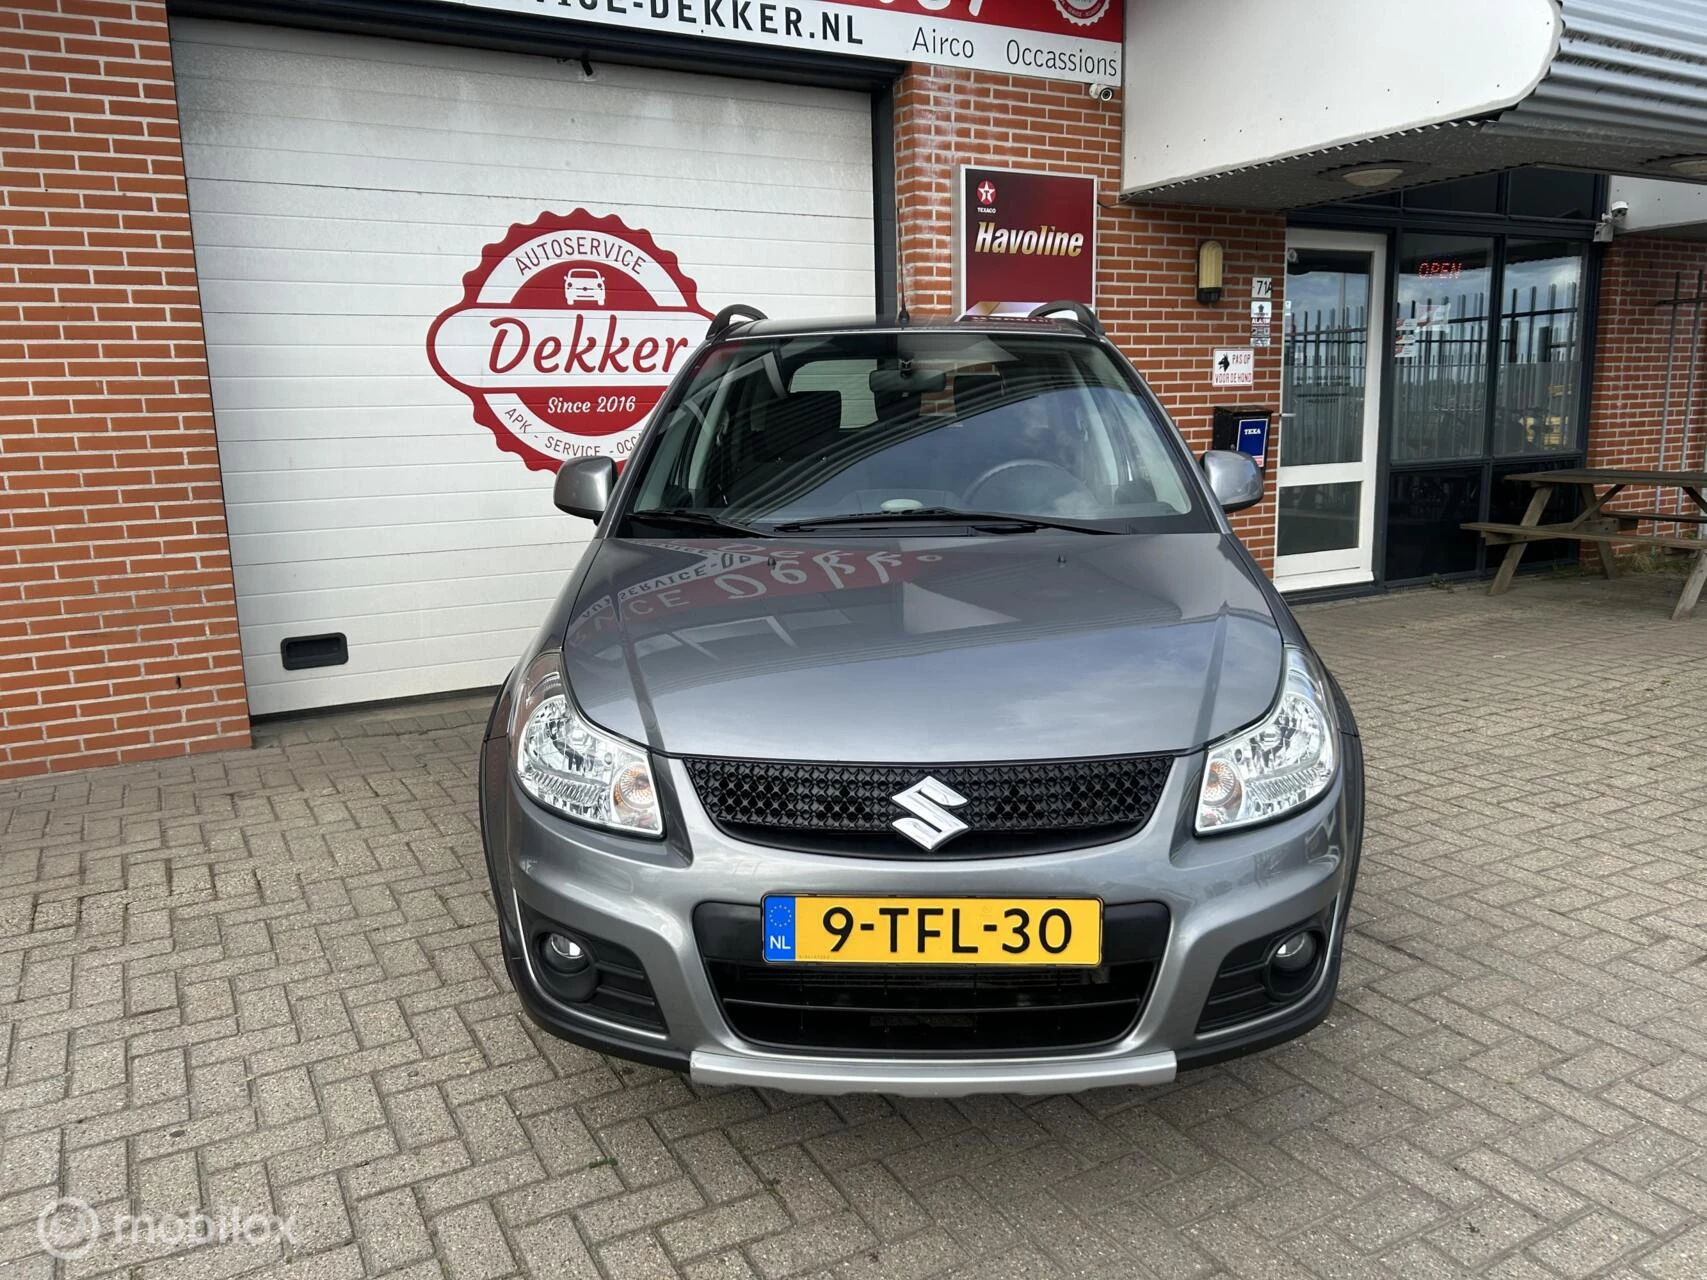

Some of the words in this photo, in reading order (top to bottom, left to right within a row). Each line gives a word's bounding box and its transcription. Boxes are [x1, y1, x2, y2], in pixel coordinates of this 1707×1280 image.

[536, 0, 864, 44] -DEKKER.NL
[912, 27, 974, 59] Airco
[1006, 39, 1117, 77] Occassions
[515, 236, 647, 276] AUTOSERVICE
[975, 221, 1084, 257] Havoline
[1417, 261, 1463, 280] OPEN
[489, 313, 689, 374] Dekker
[1231, 354, 1243, 365] PAS
[1243, 354, 1251, 365] OP
[1215, 373, 1230, 384] VOOR
[1230, 373, 1237, 383] DE
[1237, 372, 1252, 383] HOND
[547, 397, 590, 414] Since
[596, 396, 636, 413] 2016
[505, 407, 533, 434] APK
[545, 436, 601, 458] SERVICE
[769, 935, 791, 950] NL
[822, 906, 1072, 954] 9-TFL-30
